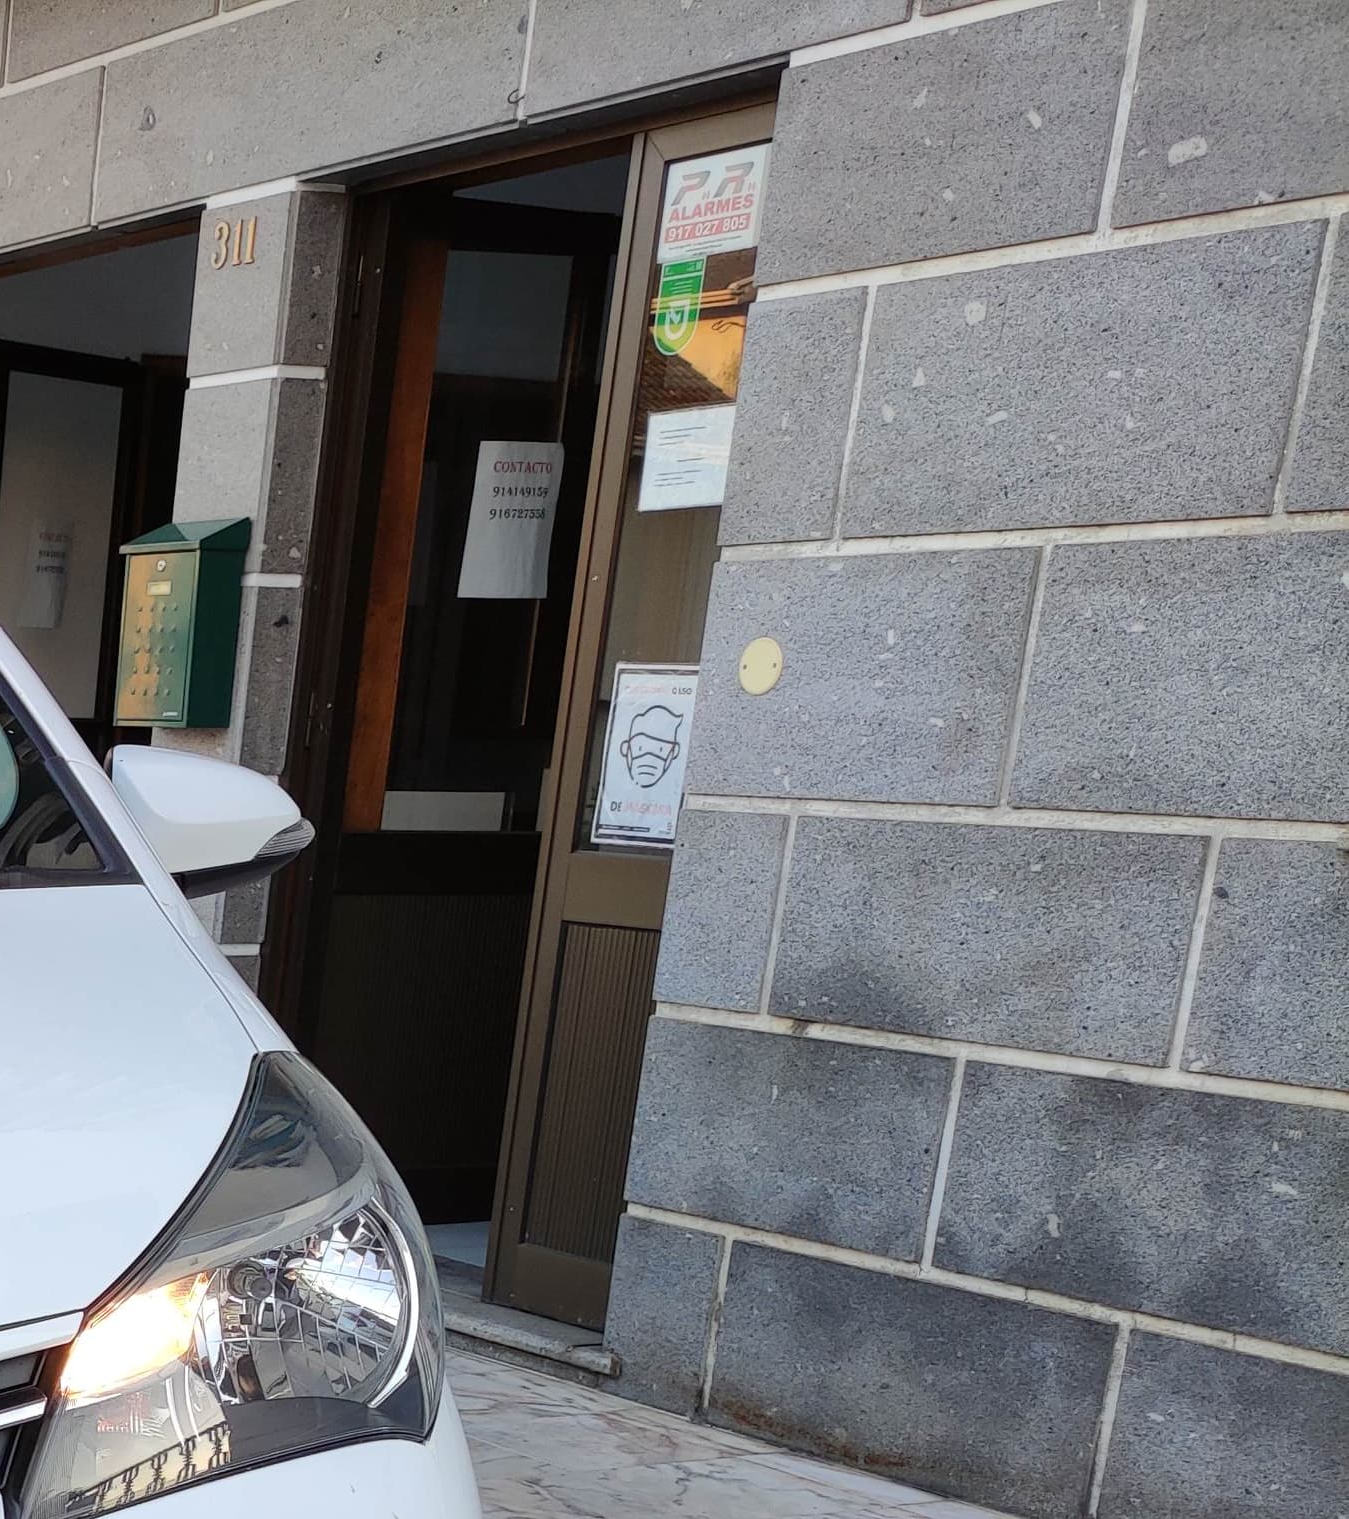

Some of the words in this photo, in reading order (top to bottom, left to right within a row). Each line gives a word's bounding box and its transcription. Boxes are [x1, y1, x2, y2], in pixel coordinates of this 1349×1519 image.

[669, 194, 754, 222] ALARMES
[668, 226, 694, 241] 917
[695, 221, 721, 235] 027
[722, 215, 747, 229] 805
[211, 217, 257, 270] 311
[493, 460, 552, 474] CONTACTO
